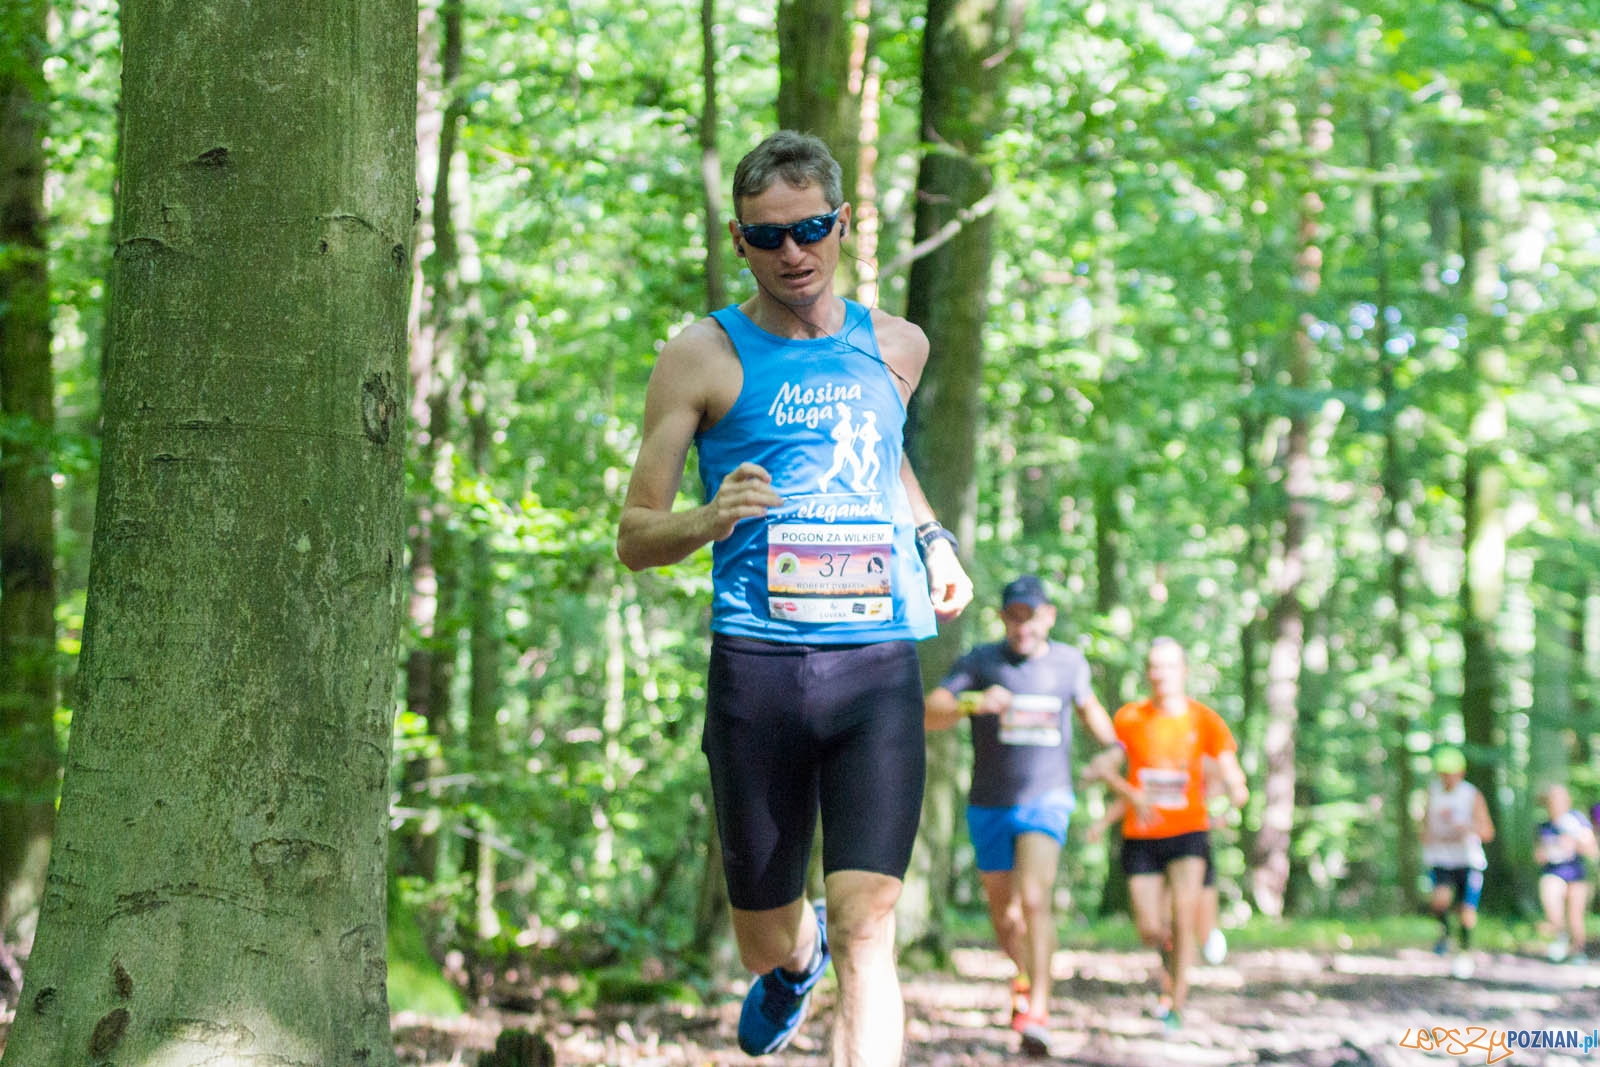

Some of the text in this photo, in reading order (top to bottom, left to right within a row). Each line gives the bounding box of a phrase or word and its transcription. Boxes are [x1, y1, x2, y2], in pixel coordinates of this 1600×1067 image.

[768, 381, 862, 417] Mosina
[775, 402, 834, 429] biega
[826, 533, 841, 543] ZA
[844, 533, 885, 542] WILKIEM
[818, 552, 851, 578] 37
